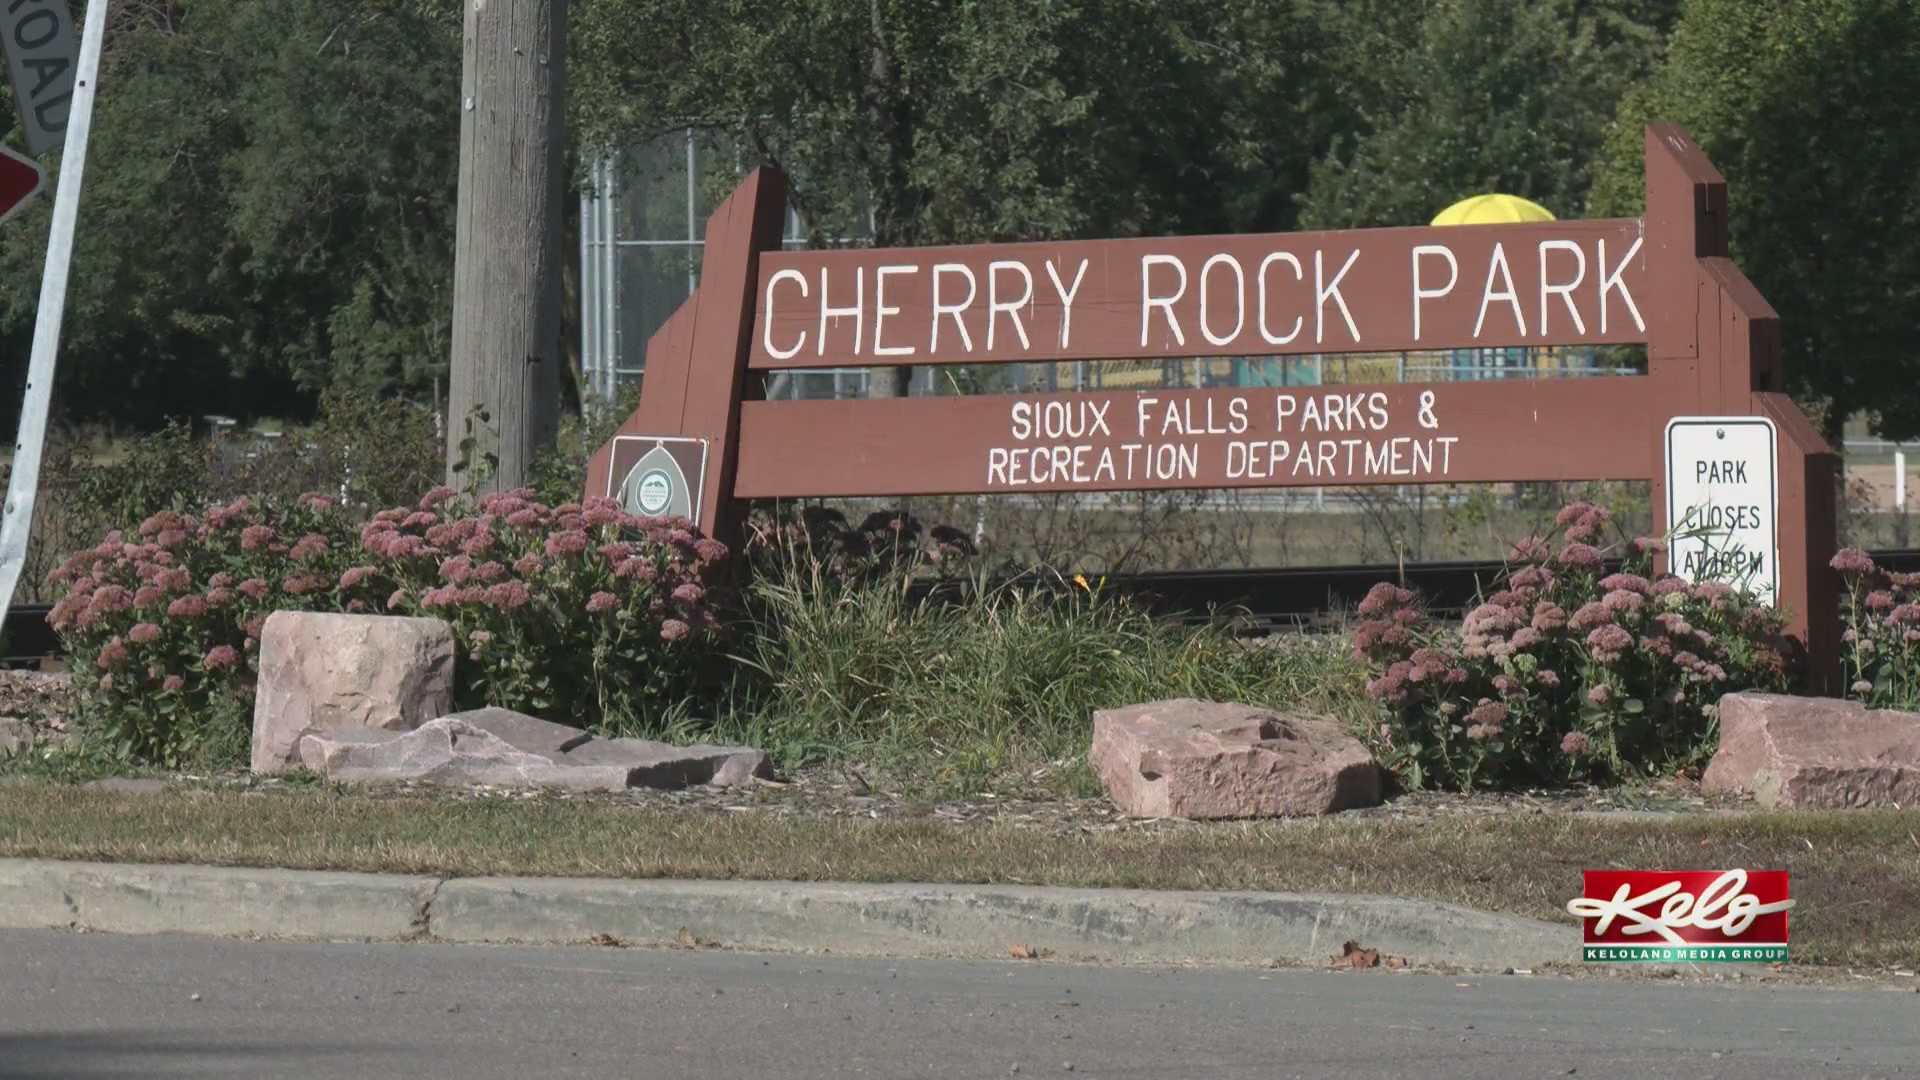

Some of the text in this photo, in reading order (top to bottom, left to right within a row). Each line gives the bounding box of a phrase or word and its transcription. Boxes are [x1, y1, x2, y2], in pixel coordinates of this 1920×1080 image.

[763, 237, 1646, 360] CHERRY ROCK PARK
[1011, 390, 1438, 440] SIOUX FALLS PARKS &
[987, 436, 1459, 486] RECREATION DEPARTMENT
[1696, 460, 1748, 484] PARK
[1685, 505, 1761, 530] CLOSES
[1683, 551, 1706, 575] AT
